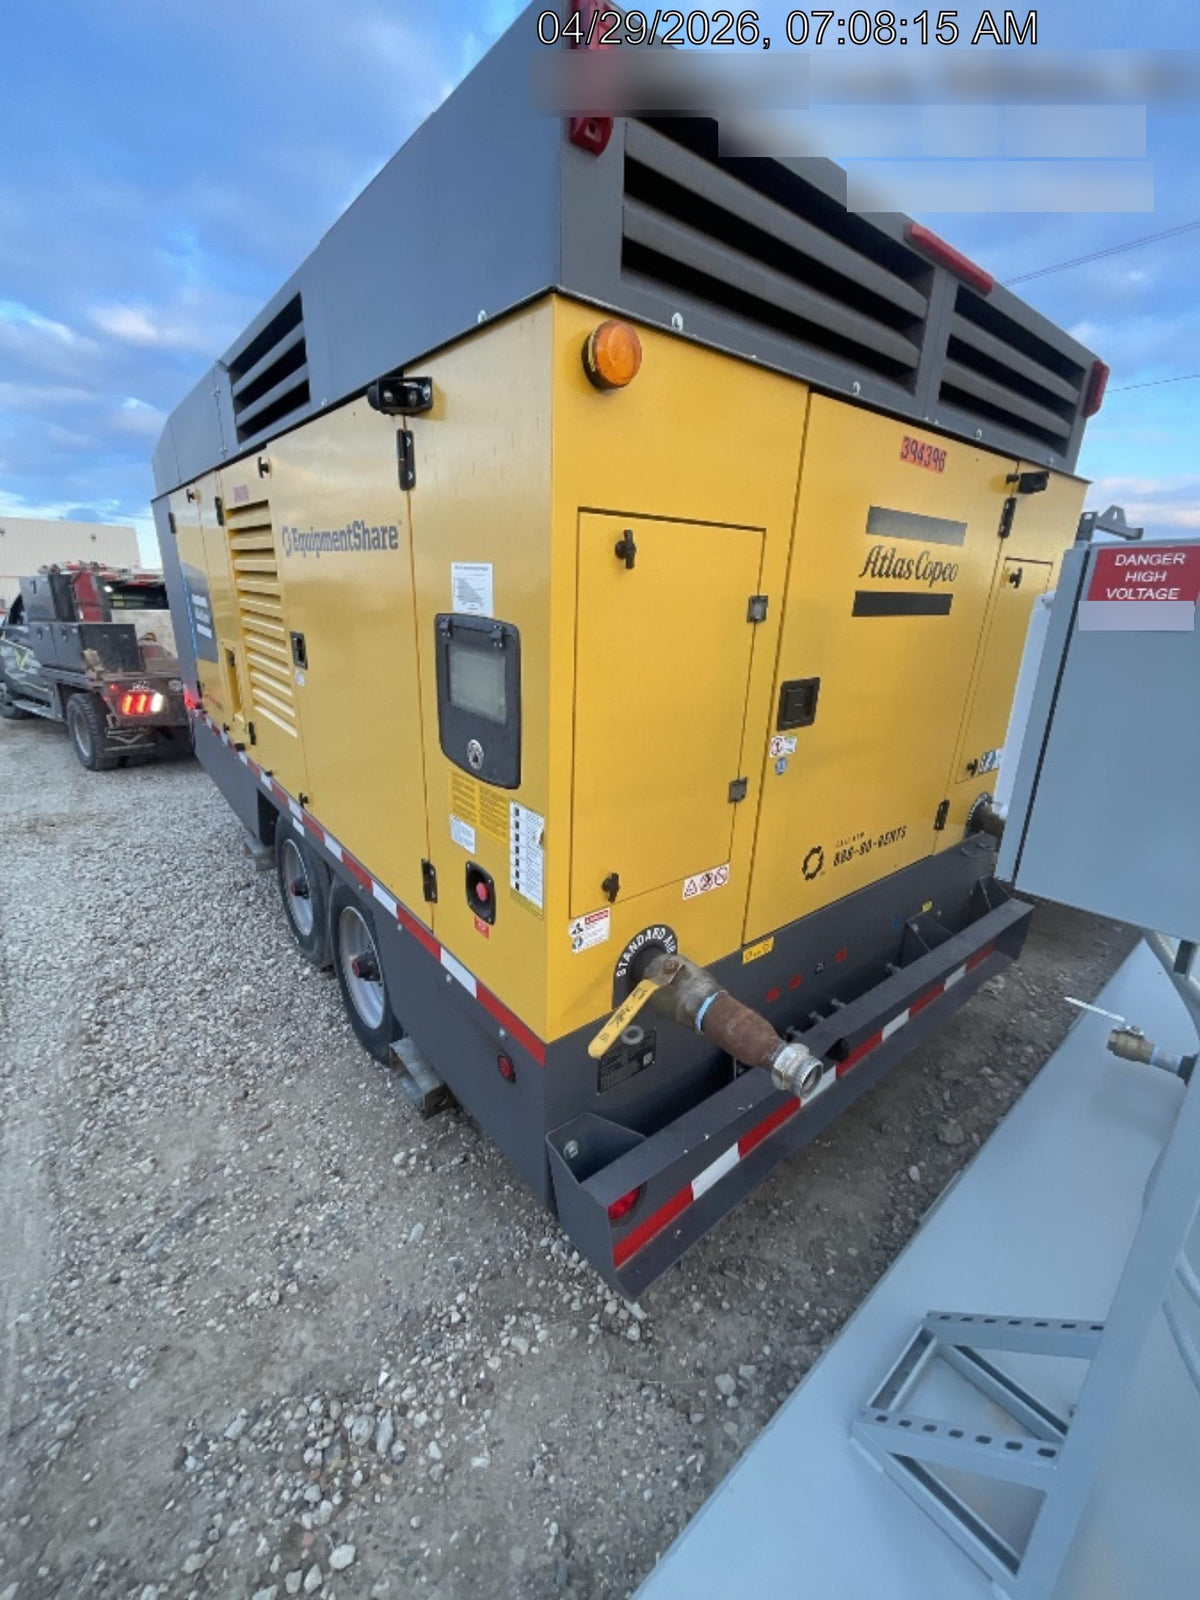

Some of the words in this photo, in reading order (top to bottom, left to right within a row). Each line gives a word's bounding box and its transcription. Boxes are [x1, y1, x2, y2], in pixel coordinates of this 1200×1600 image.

[291, 520, 399, 559] EquipmentShare
[859, 544, 915, 581] Atlas
[915, 550, 959, 588] Copco
[1114, 552, 1186, 567] DANGER
[1125, 570, 1167, 582] HIGH
[1105, 587, 1181, 600] VOLTAGE
[616, 927, 666, 977] STANDARD
